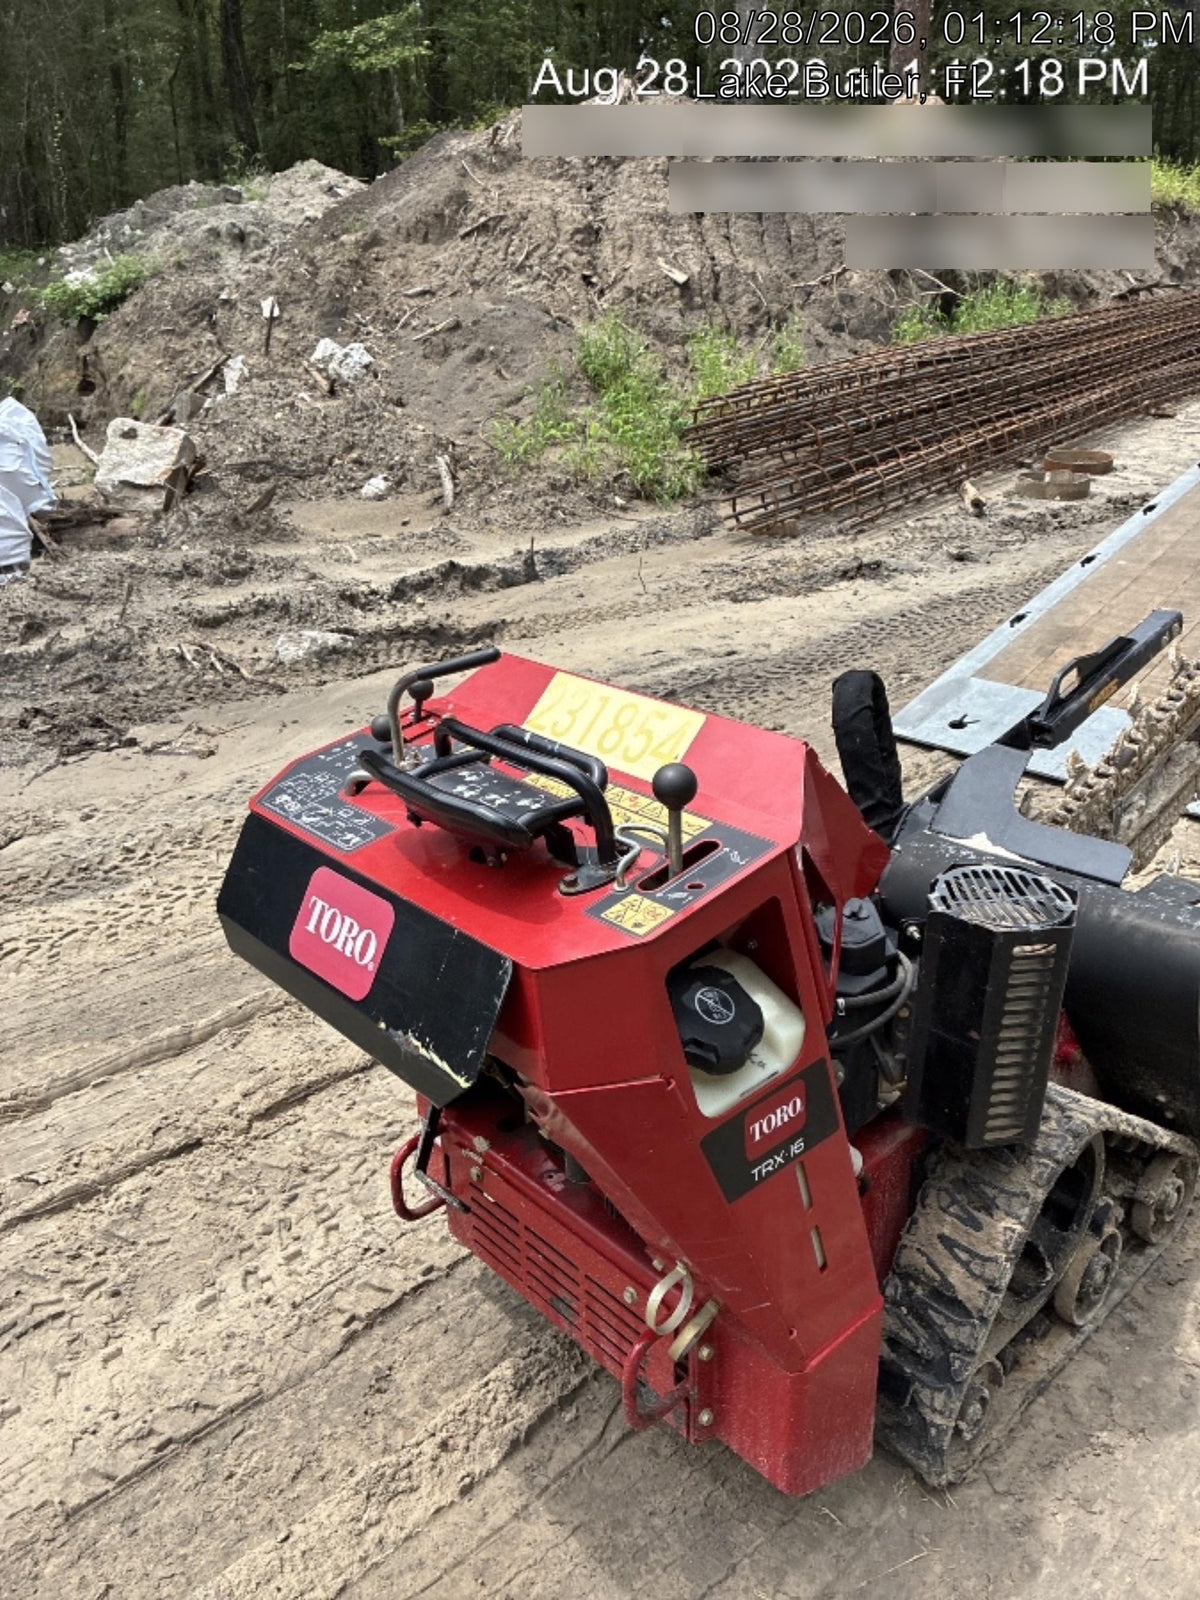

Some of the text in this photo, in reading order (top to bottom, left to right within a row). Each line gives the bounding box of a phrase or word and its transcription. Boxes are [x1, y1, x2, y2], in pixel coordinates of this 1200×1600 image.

[526, 680, 693, 764] 231854
[305, 895, 377, 968] TORO
[749, 1096, 803, 1143] TORO
